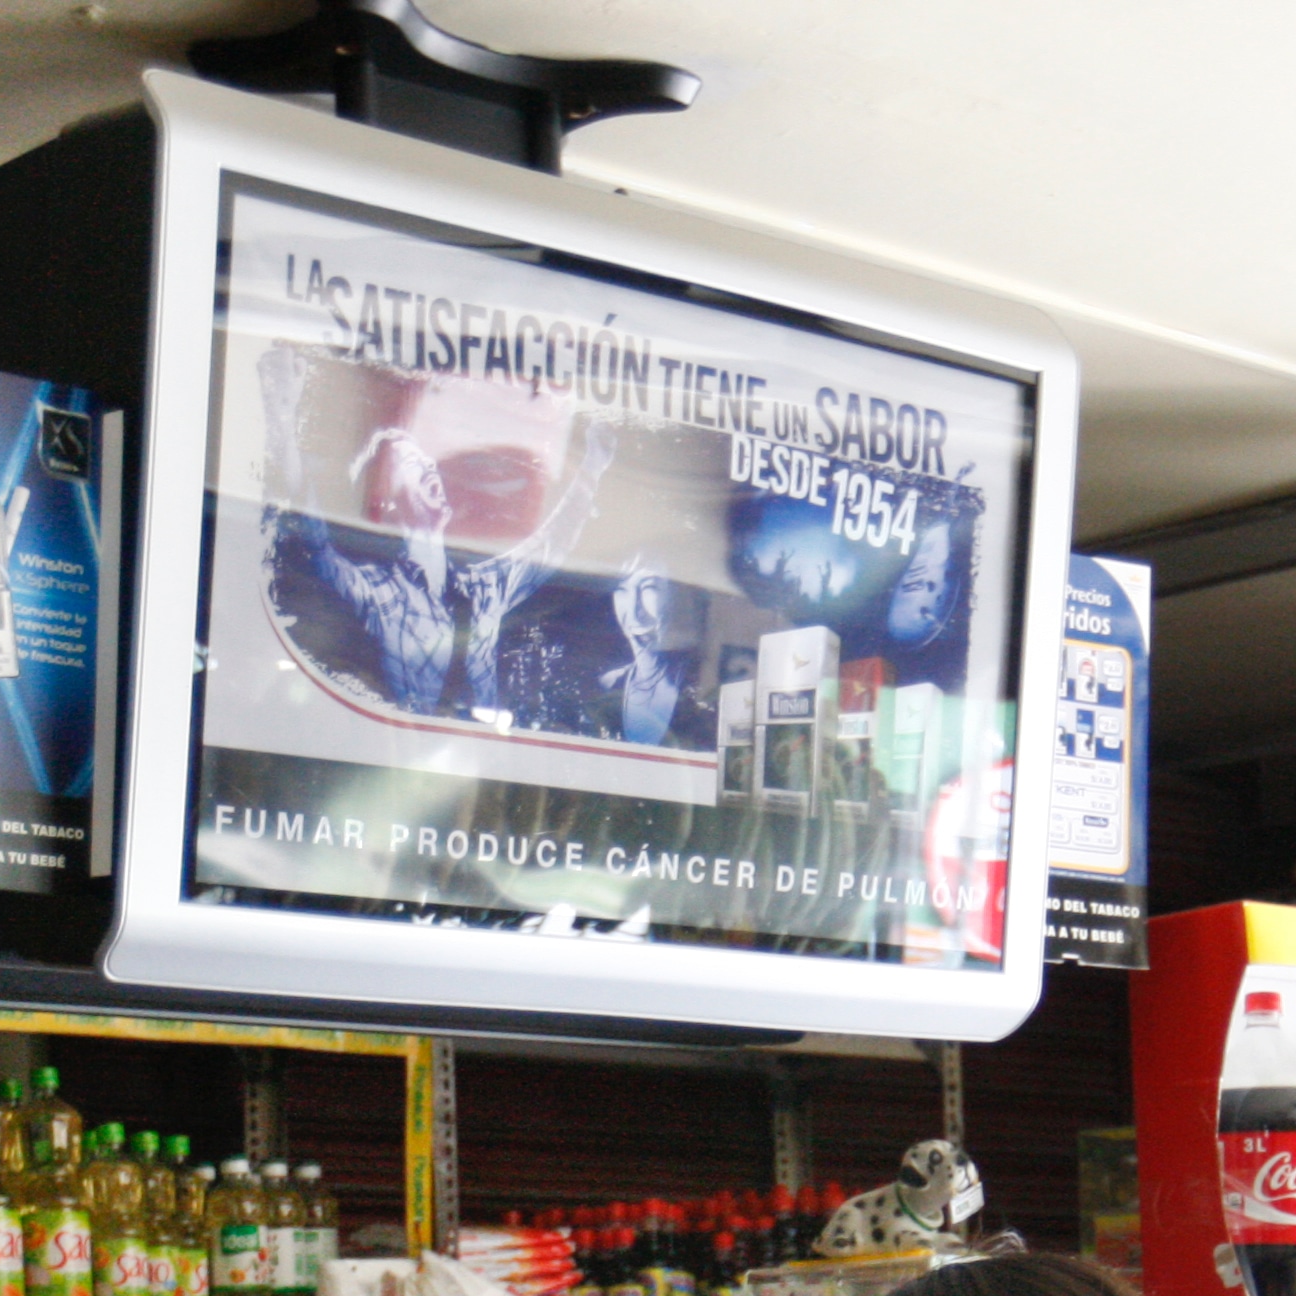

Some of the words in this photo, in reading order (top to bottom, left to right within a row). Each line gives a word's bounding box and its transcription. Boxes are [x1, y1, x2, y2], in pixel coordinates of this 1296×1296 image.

[286, 253, 328, 299] LA
[323, 275, 651, 411] SATISFACCIÓN
[659, 355, 768, 437] TIENE
[773, 400, 809, 445] UN
[814, 386, 949, 476] SABOR
[730, 432, 828, 507] DESDE
[831, 467, 918, 556] 1954
[18, 552, 84, 575] Winston
[1064, 583, 1112, 608] Precios
[2, 819, 27, 836] DEL
[31, 822, 84, 841] TABACO
[8, 850, 27, 866] TU
[30, 850, 66, 869] BEBÉ
[213, 804, 365, 851] FUMAR
[388, 822, 585, 872] PRODUCE
[605, 841, 758, 890] CÁNCER
[775, 865, 820, 896] DE
[837, 872, 976, 912] PULMÓN
[1063, 898, 1087, 914] DEL
[1090, 902, 1140, 919] TABACO
[1071, 927, 1088, 941] TU
[1090, 929, 1125, 944] BEBÉ
[1243, 1138, 1253, 1153] 3
[1257, 1138, 1266, 1153] L
